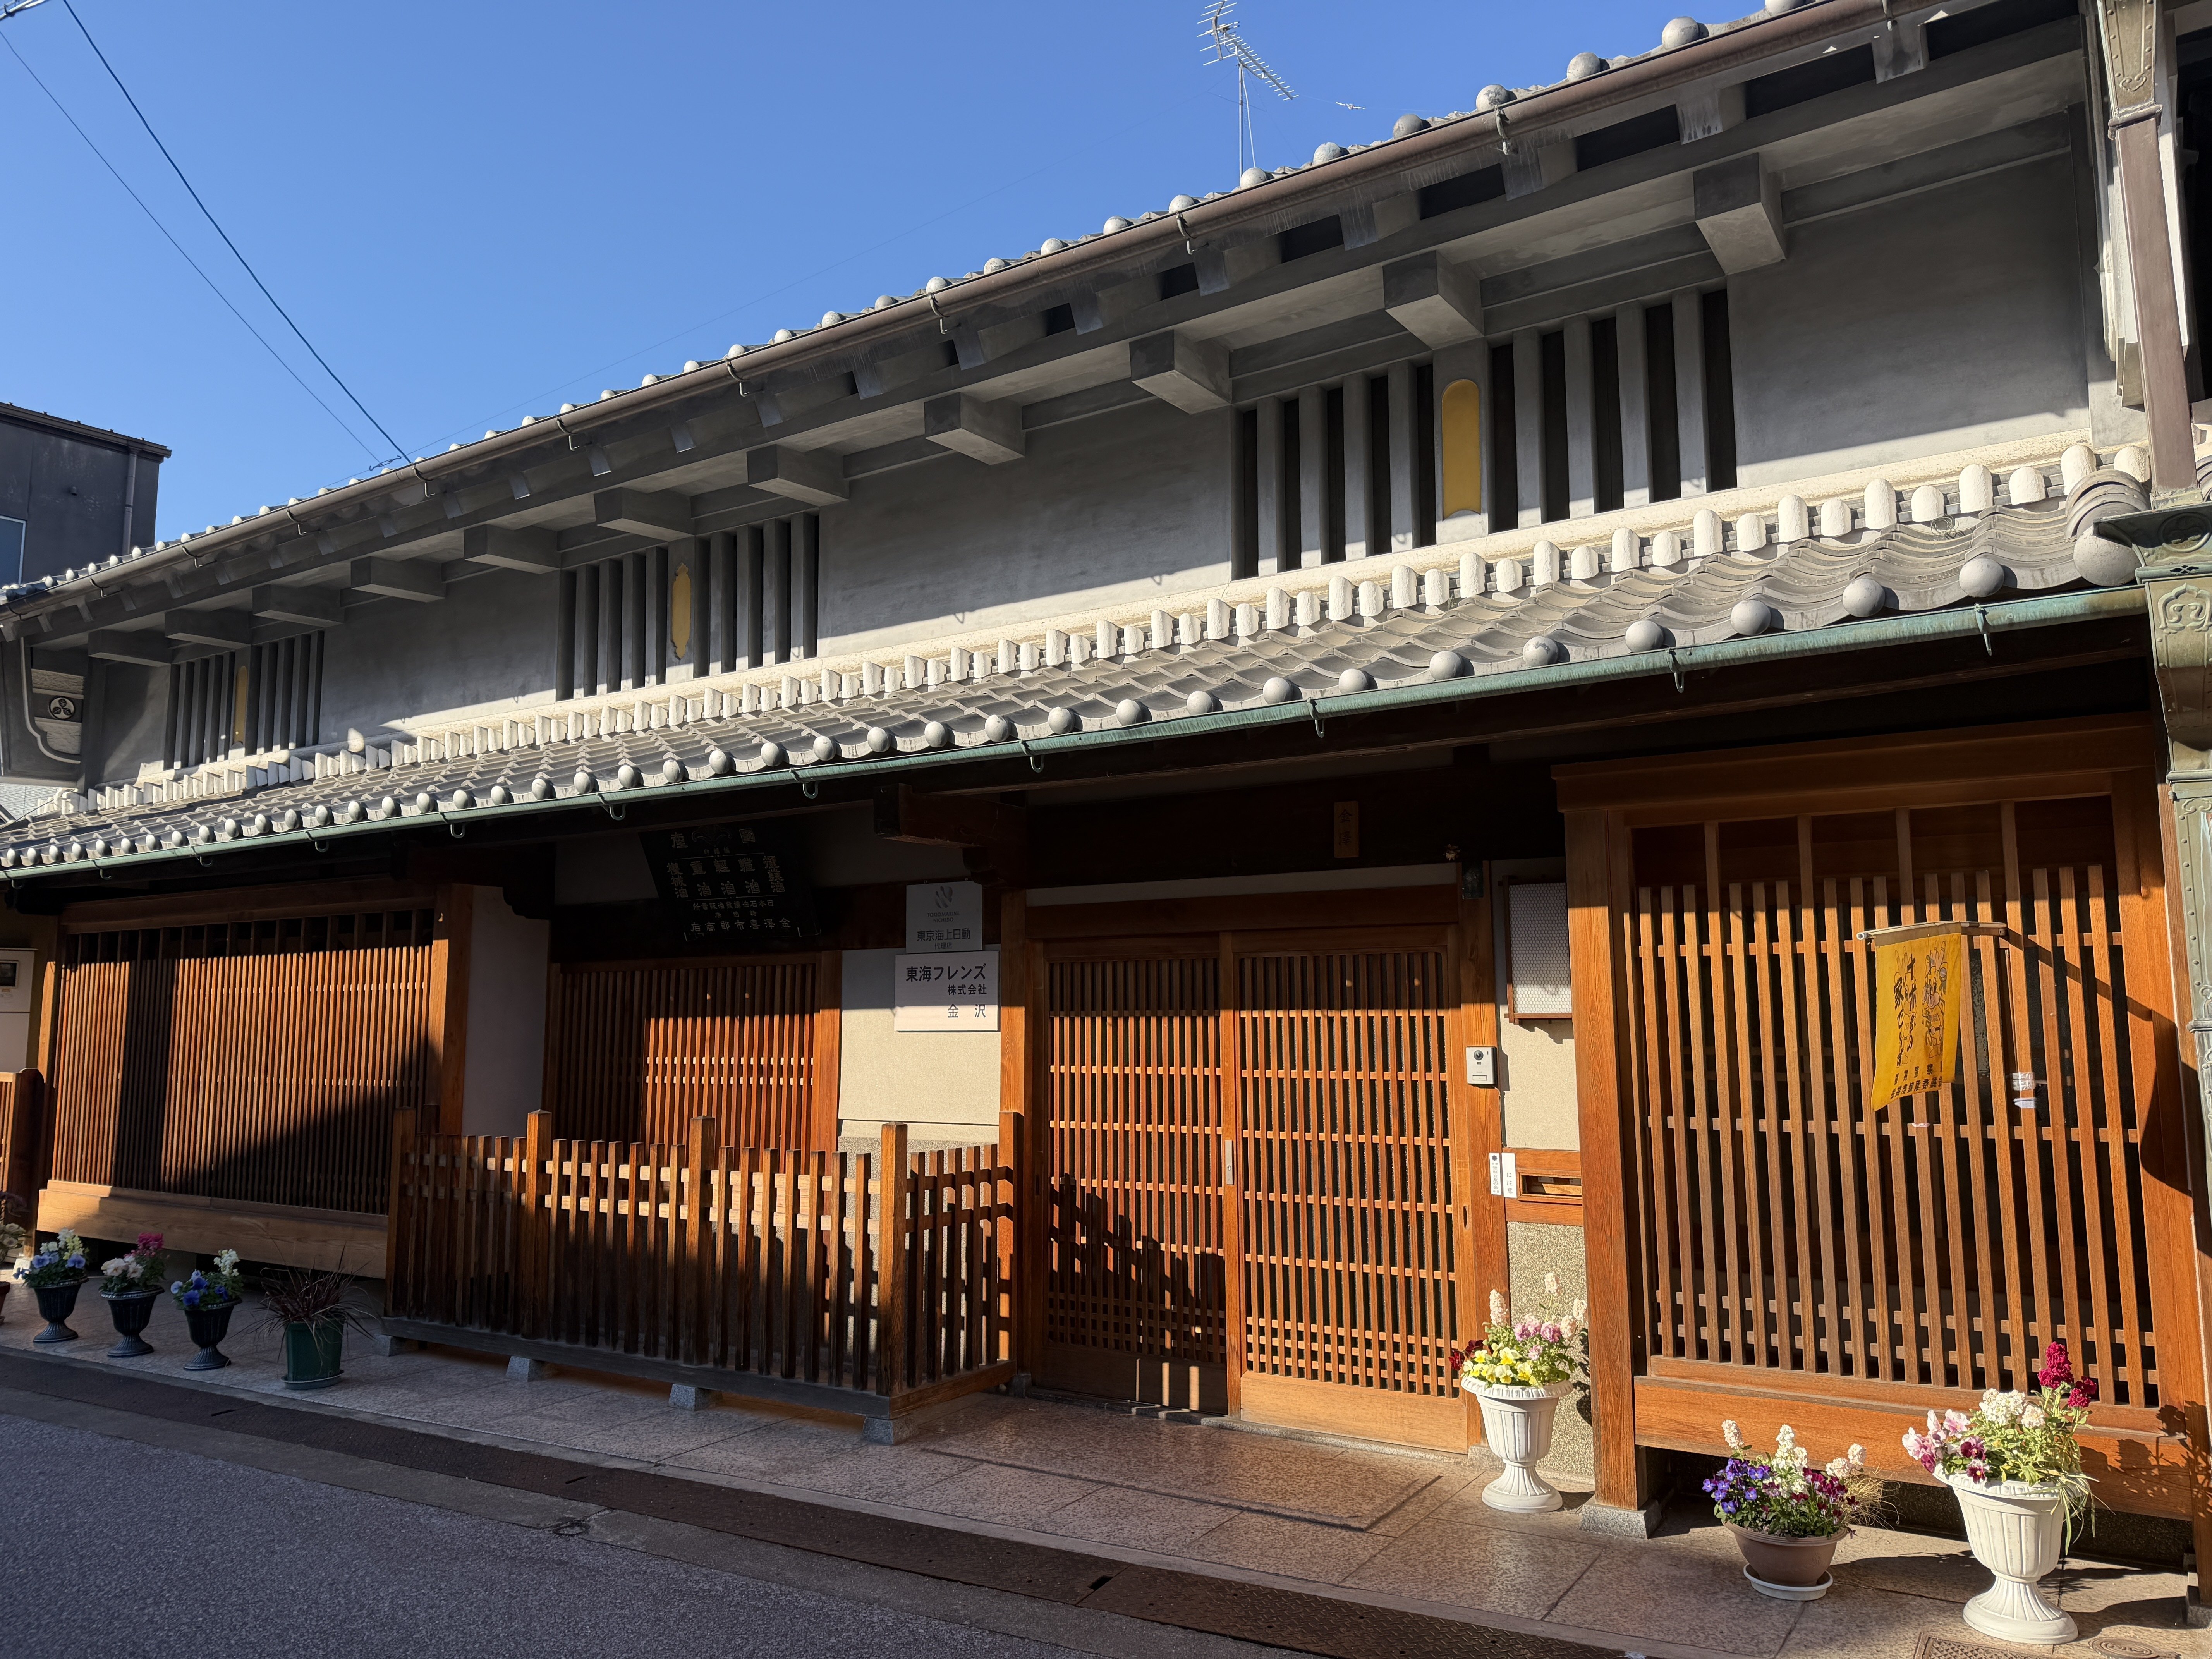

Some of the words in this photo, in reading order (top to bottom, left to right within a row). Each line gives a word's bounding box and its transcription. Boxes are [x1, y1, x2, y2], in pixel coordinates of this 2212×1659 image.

[917, 928, 971, 942] 東京海上日動
[906, 963, 987, 982] 東海フレンズ
[947, 984, 987, 996] 株式会社
[947, 1003, 986, 1018] 金沢
